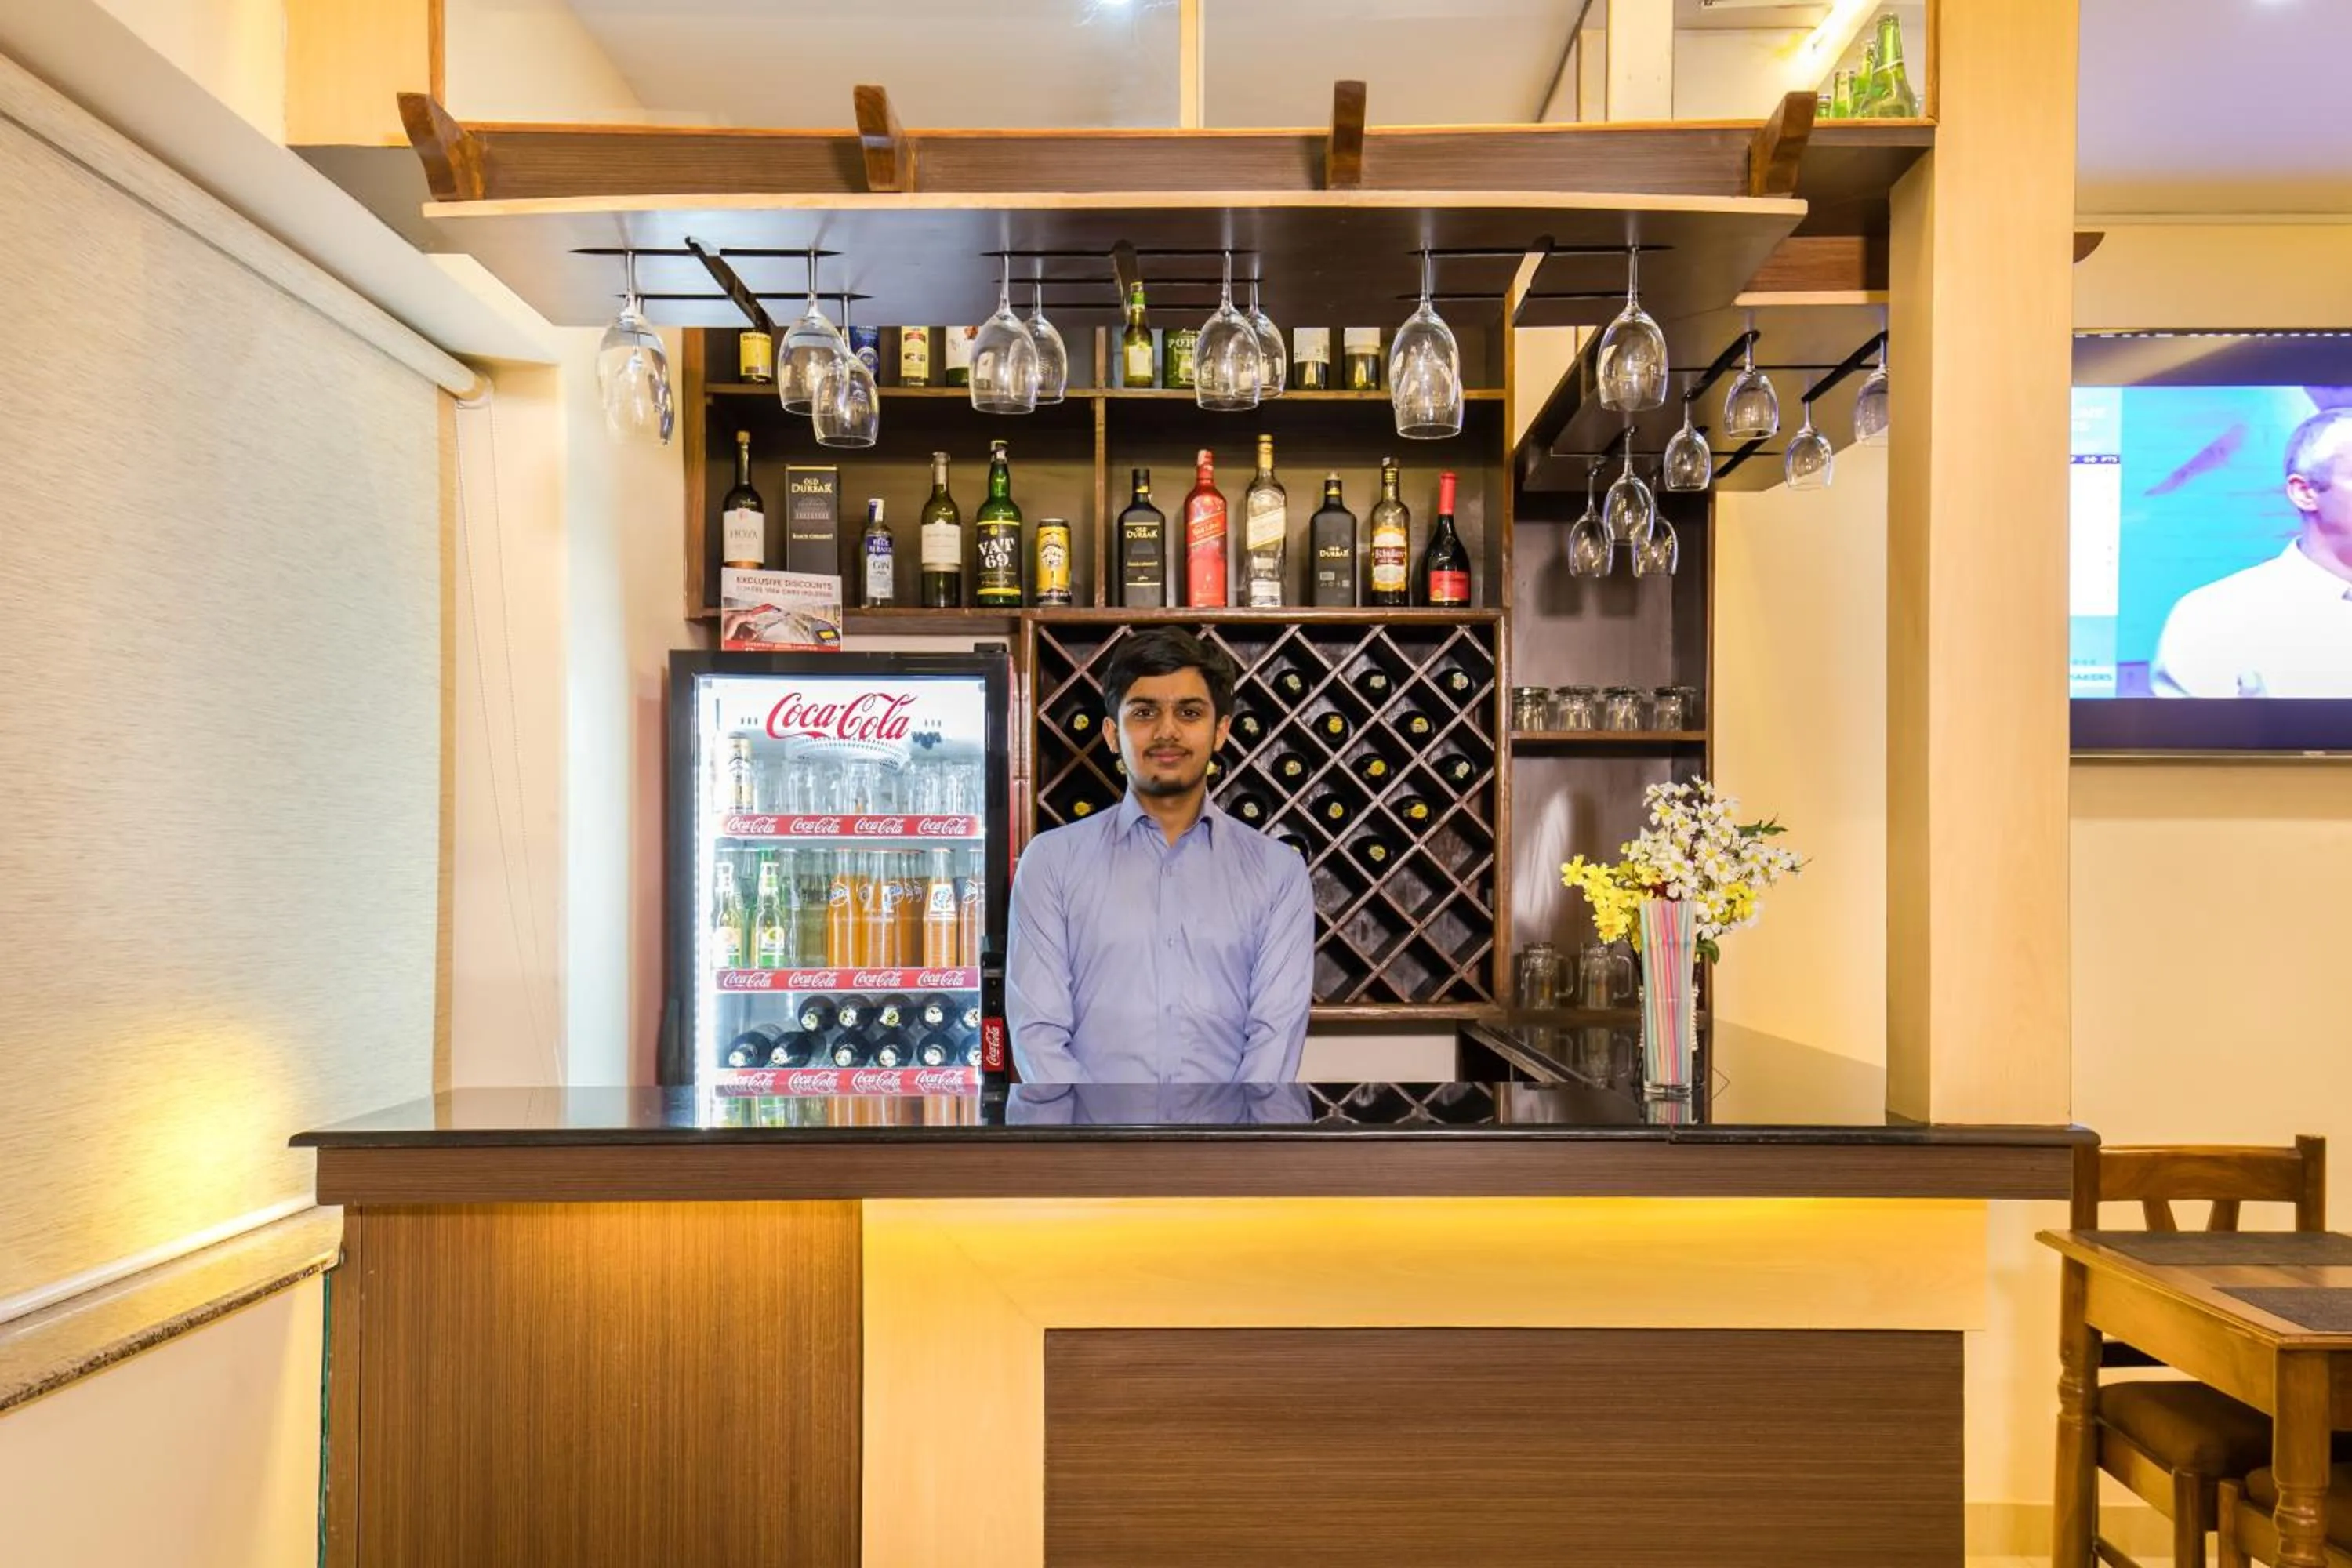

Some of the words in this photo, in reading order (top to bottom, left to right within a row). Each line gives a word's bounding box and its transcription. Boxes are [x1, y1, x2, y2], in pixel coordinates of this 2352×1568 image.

[791, 483, 833, 493] DURBAR
[1126, 530, 1158, 539] DURBAR
[978, 538, 1014, 555] VAT
[873, 561, 890, 569] GIN
[736, 576, 782, 586] EXCLUSIVE
[785, 580, 833, 590] DISCOUNTS
